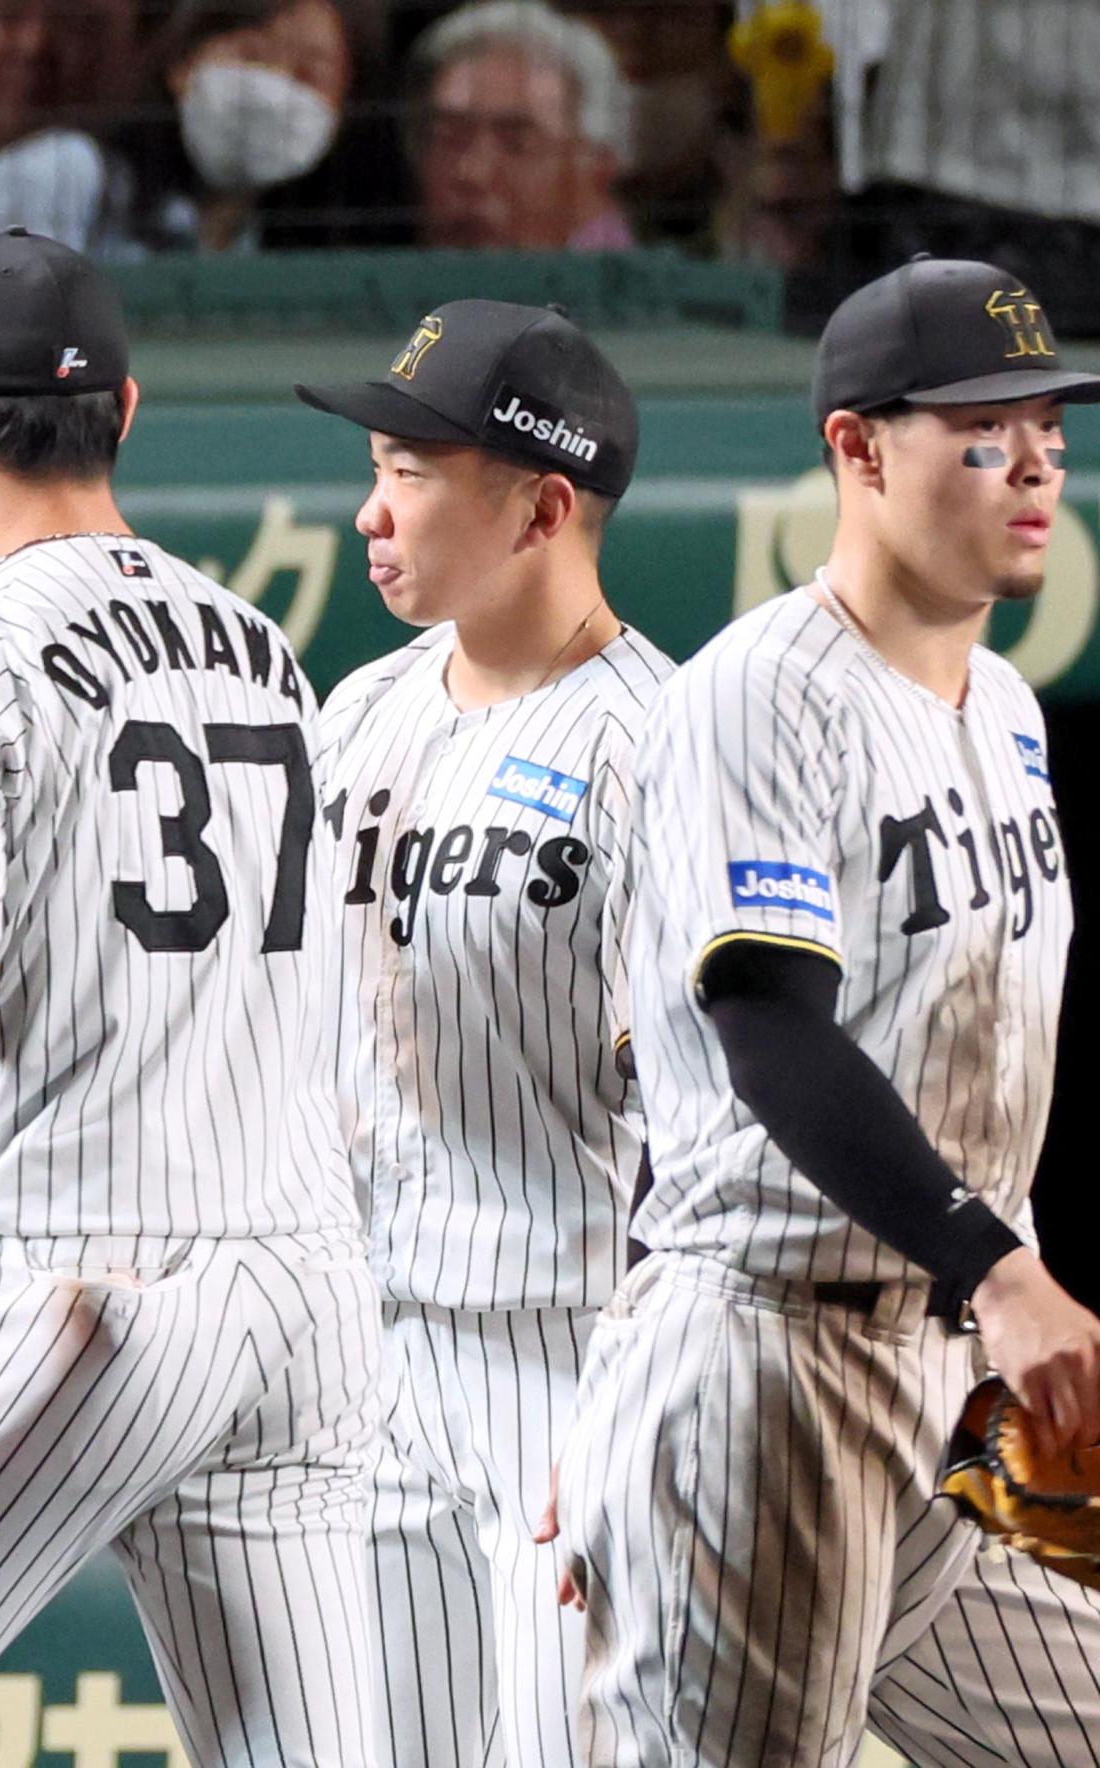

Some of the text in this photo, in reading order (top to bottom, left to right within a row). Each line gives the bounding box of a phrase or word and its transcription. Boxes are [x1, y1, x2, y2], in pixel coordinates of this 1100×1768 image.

[493, 397, 598, 462] Joshin
[491, 764, 582, 815] Joshin
[108, 719, 315, 954] 37
[879, 787, 1063, 942] Tige
[736, 869, 832, 906] Joshin
